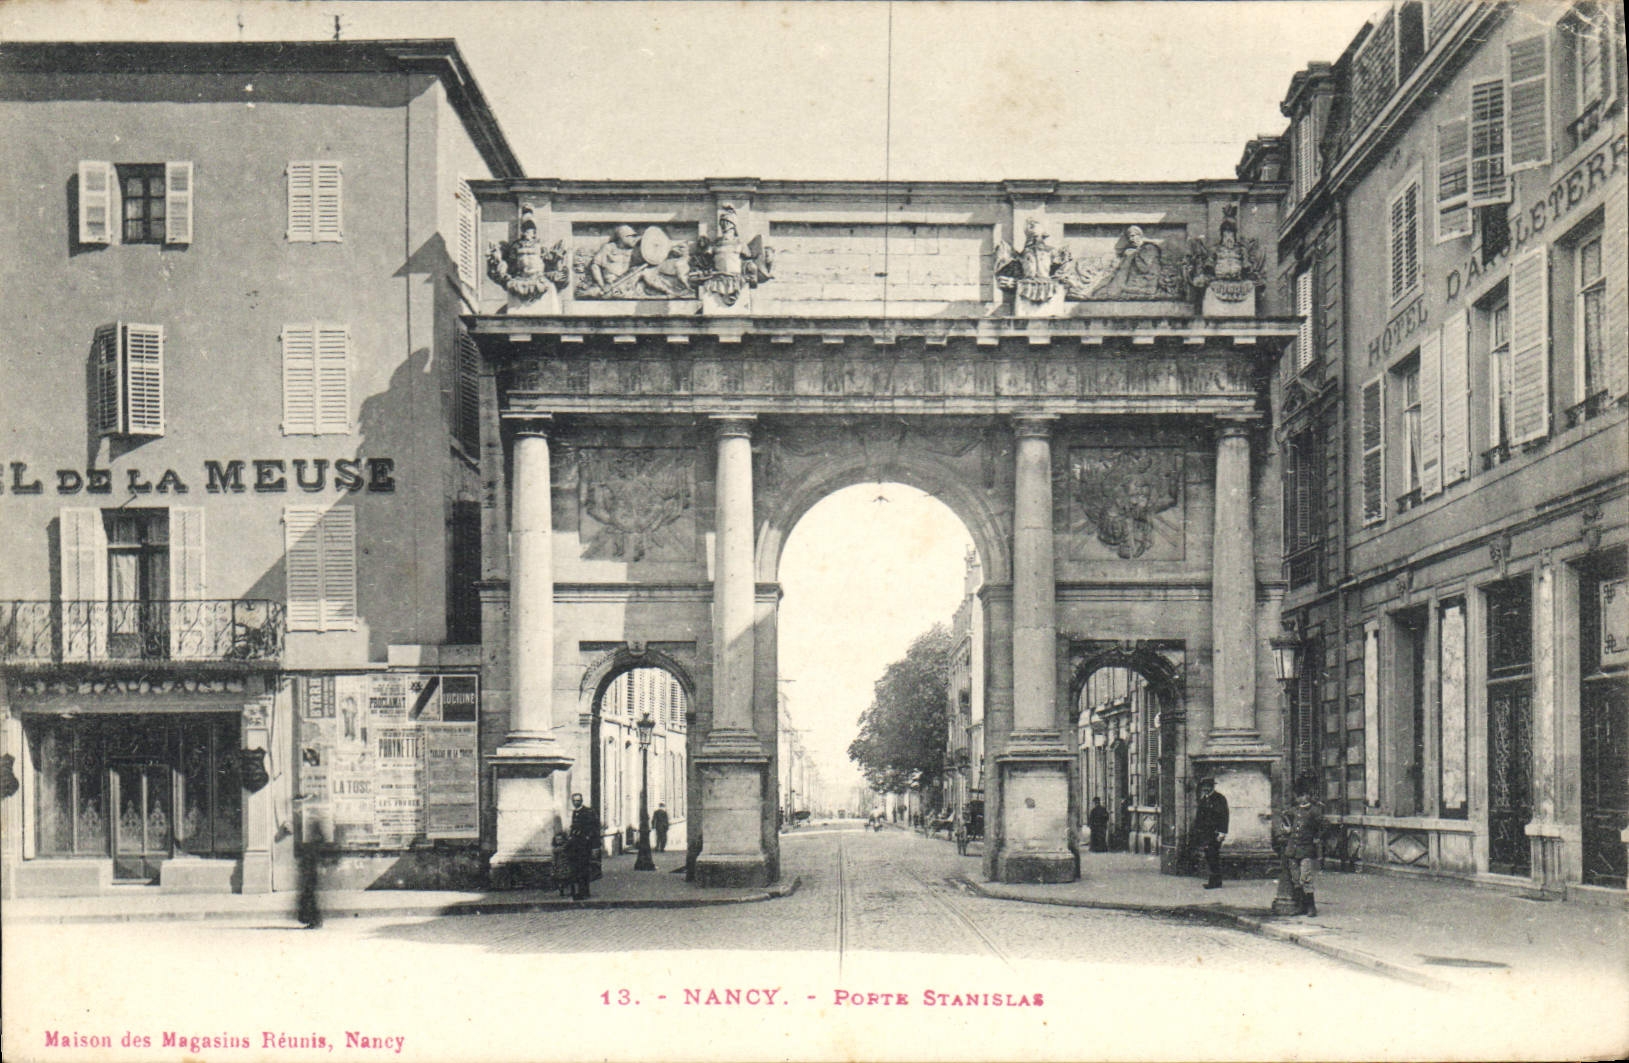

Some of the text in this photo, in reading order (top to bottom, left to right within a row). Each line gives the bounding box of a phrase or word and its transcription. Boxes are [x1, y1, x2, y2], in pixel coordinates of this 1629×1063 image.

[0, 458, 396, 494] L DE LA MEUSE
[333, 780, 345, 794] LA
